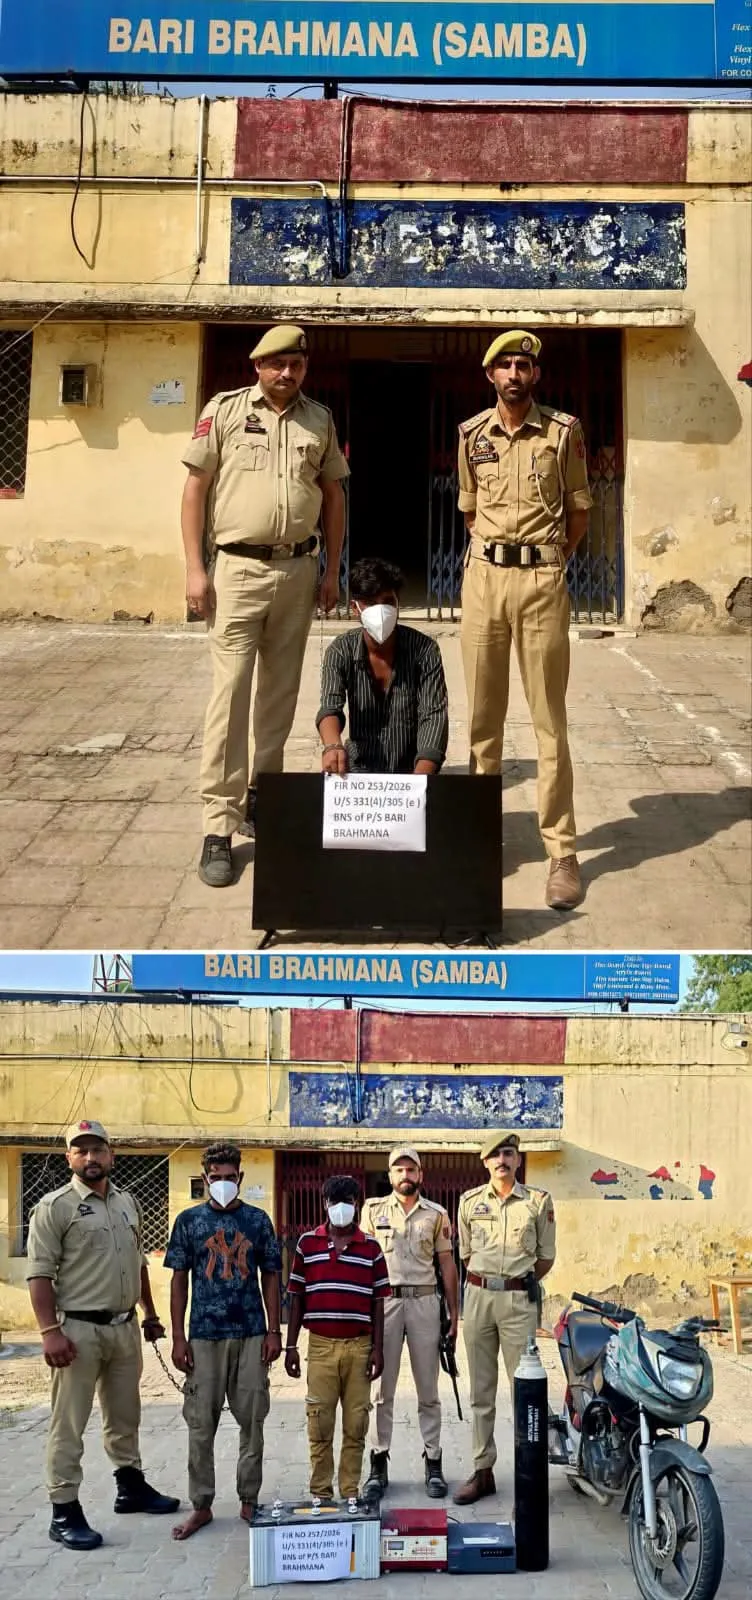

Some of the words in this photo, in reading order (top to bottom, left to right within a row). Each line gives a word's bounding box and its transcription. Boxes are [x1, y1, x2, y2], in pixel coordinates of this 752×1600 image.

[108, 17, 195, 54] BARI
[208, 19, 419, 57] BRAHMANA
[432, 22, 587, 67] (SAMBA)
[721, 69, 738, 77] FOR
[334, 781, 348, 791] FIR
[350, 781, 365, 791] NO
[367, 781, 411, 792] 253/2026
[334, 796, 351, 807] U/S
[353, 797, 404, 808] 331(4)/305
[334, 813, 352, 822] BNS
[354, 812, 364, 822] of
[366, 812, 382, 823] P/S
[384, 813, 406, 822] BARI
[333, 828, 390, 838] BRAHMANA
[204, 954, 261, 979] BARI
[268, 955, 404, 983] BRAHMANA
[411, 959, 507, 990] (SAMBA)
[282, 1531, 293, 1539] FIR
[282, 1542, 295, 1551] U/S
[282, 1553, 297, 1561] BNS
[307, 1552, 319, 1560] P/S
[320, 1551, 337, 1559] BARI
[282, 1563, 325, 1571] BRAHMANA
